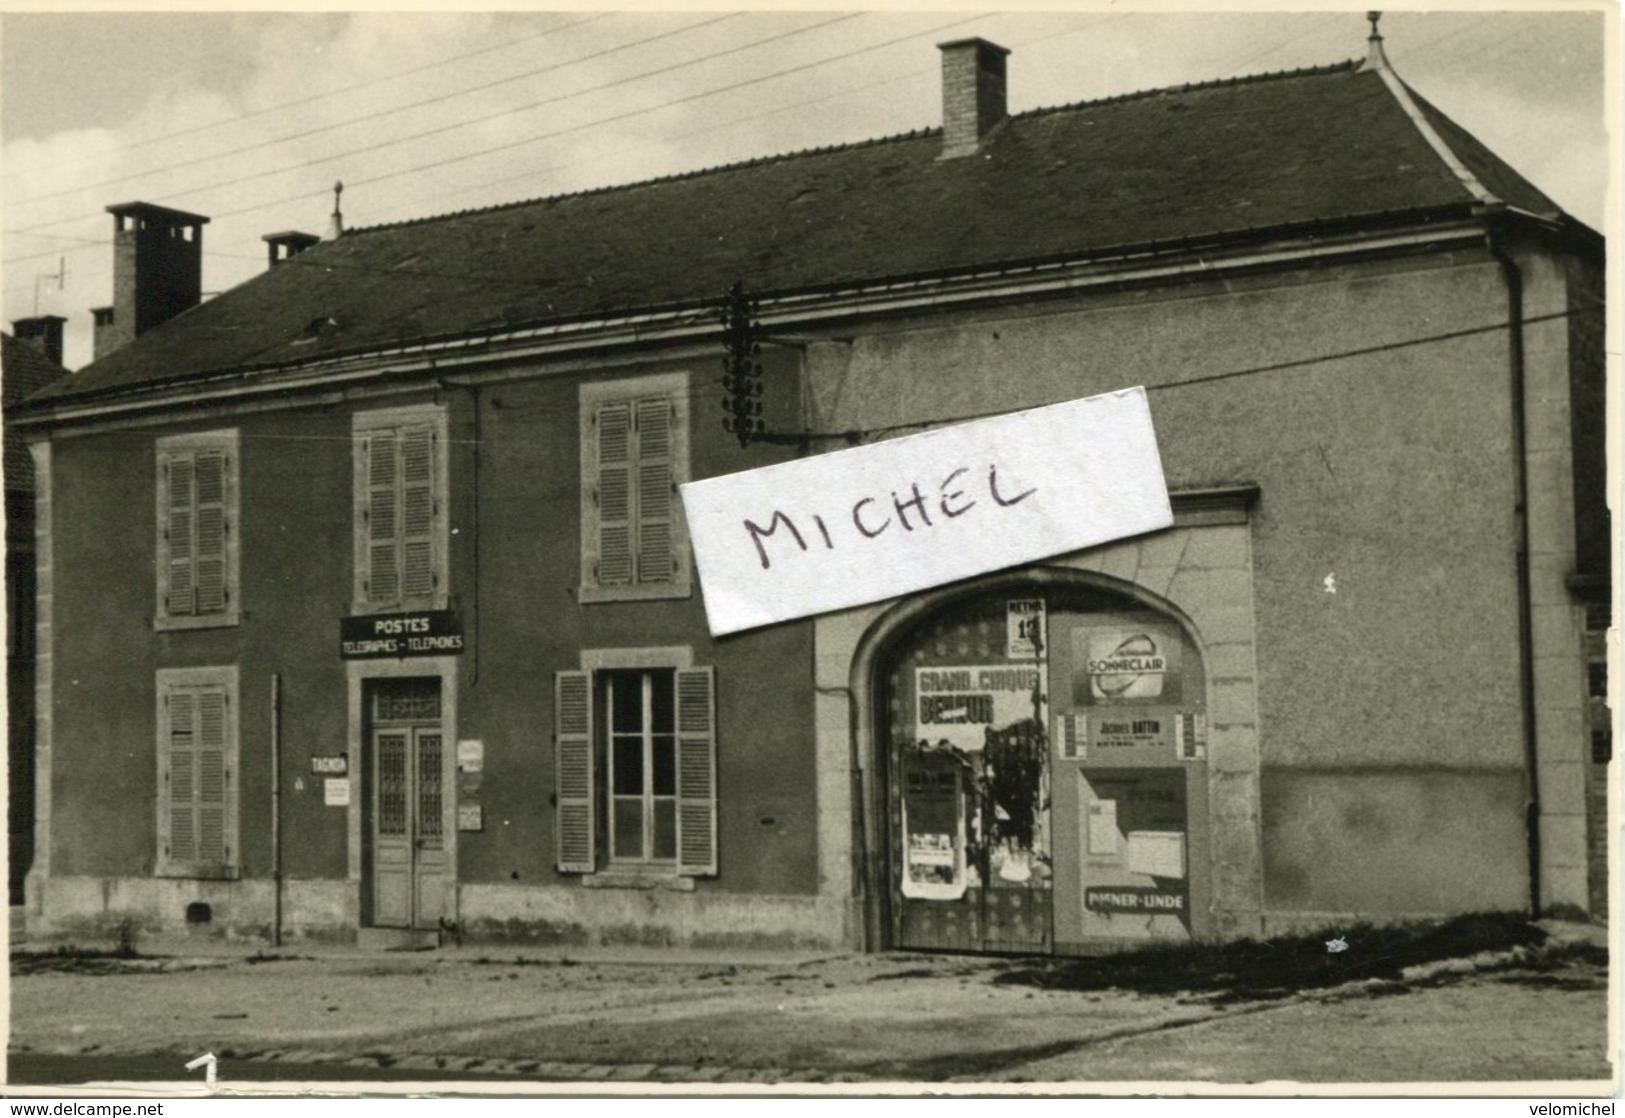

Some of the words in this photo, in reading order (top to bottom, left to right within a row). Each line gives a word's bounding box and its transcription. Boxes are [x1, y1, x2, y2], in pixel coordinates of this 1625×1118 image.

[741, 464, 1038, 570] MICHEL
[375, 618, 430, 634] POSTES
[1088, 658, 1164, 673] SONNECLAIR
[920, 671, 971, 692] GRAND
[979, 669, 1039, 692] CIRQUE
